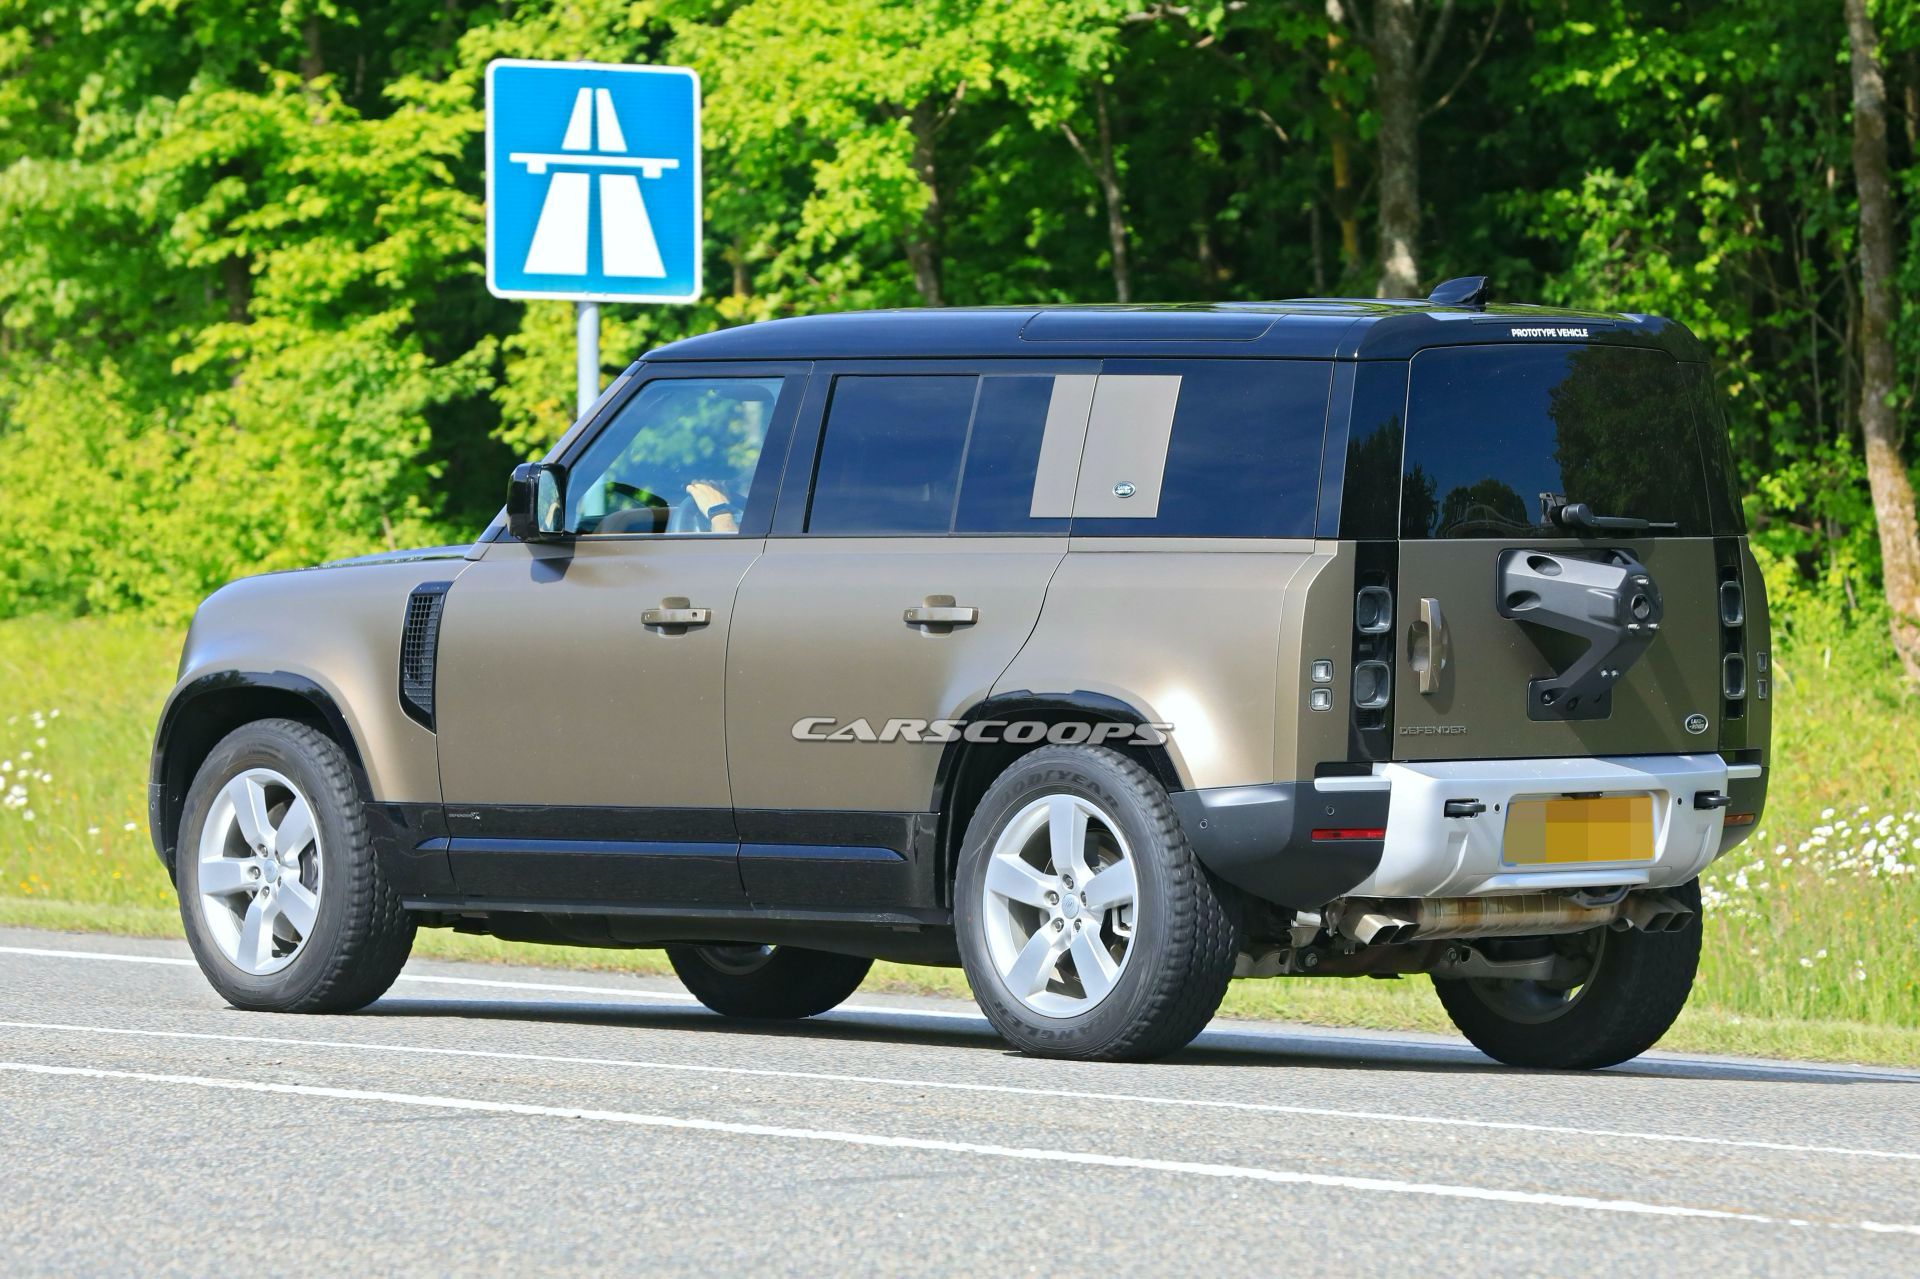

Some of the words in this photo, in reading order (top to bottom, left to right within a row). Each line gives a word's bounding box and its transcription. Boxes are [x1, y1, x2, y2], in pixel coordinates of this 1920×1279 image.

[1511, 328, 1556, 337] PROTOTYPE
[1557, 328, 1589, 337] VEHICLE
[1400, 725, 1467, 735] DEFENDER
[998, 769, 1119, 812] OODYEAR
